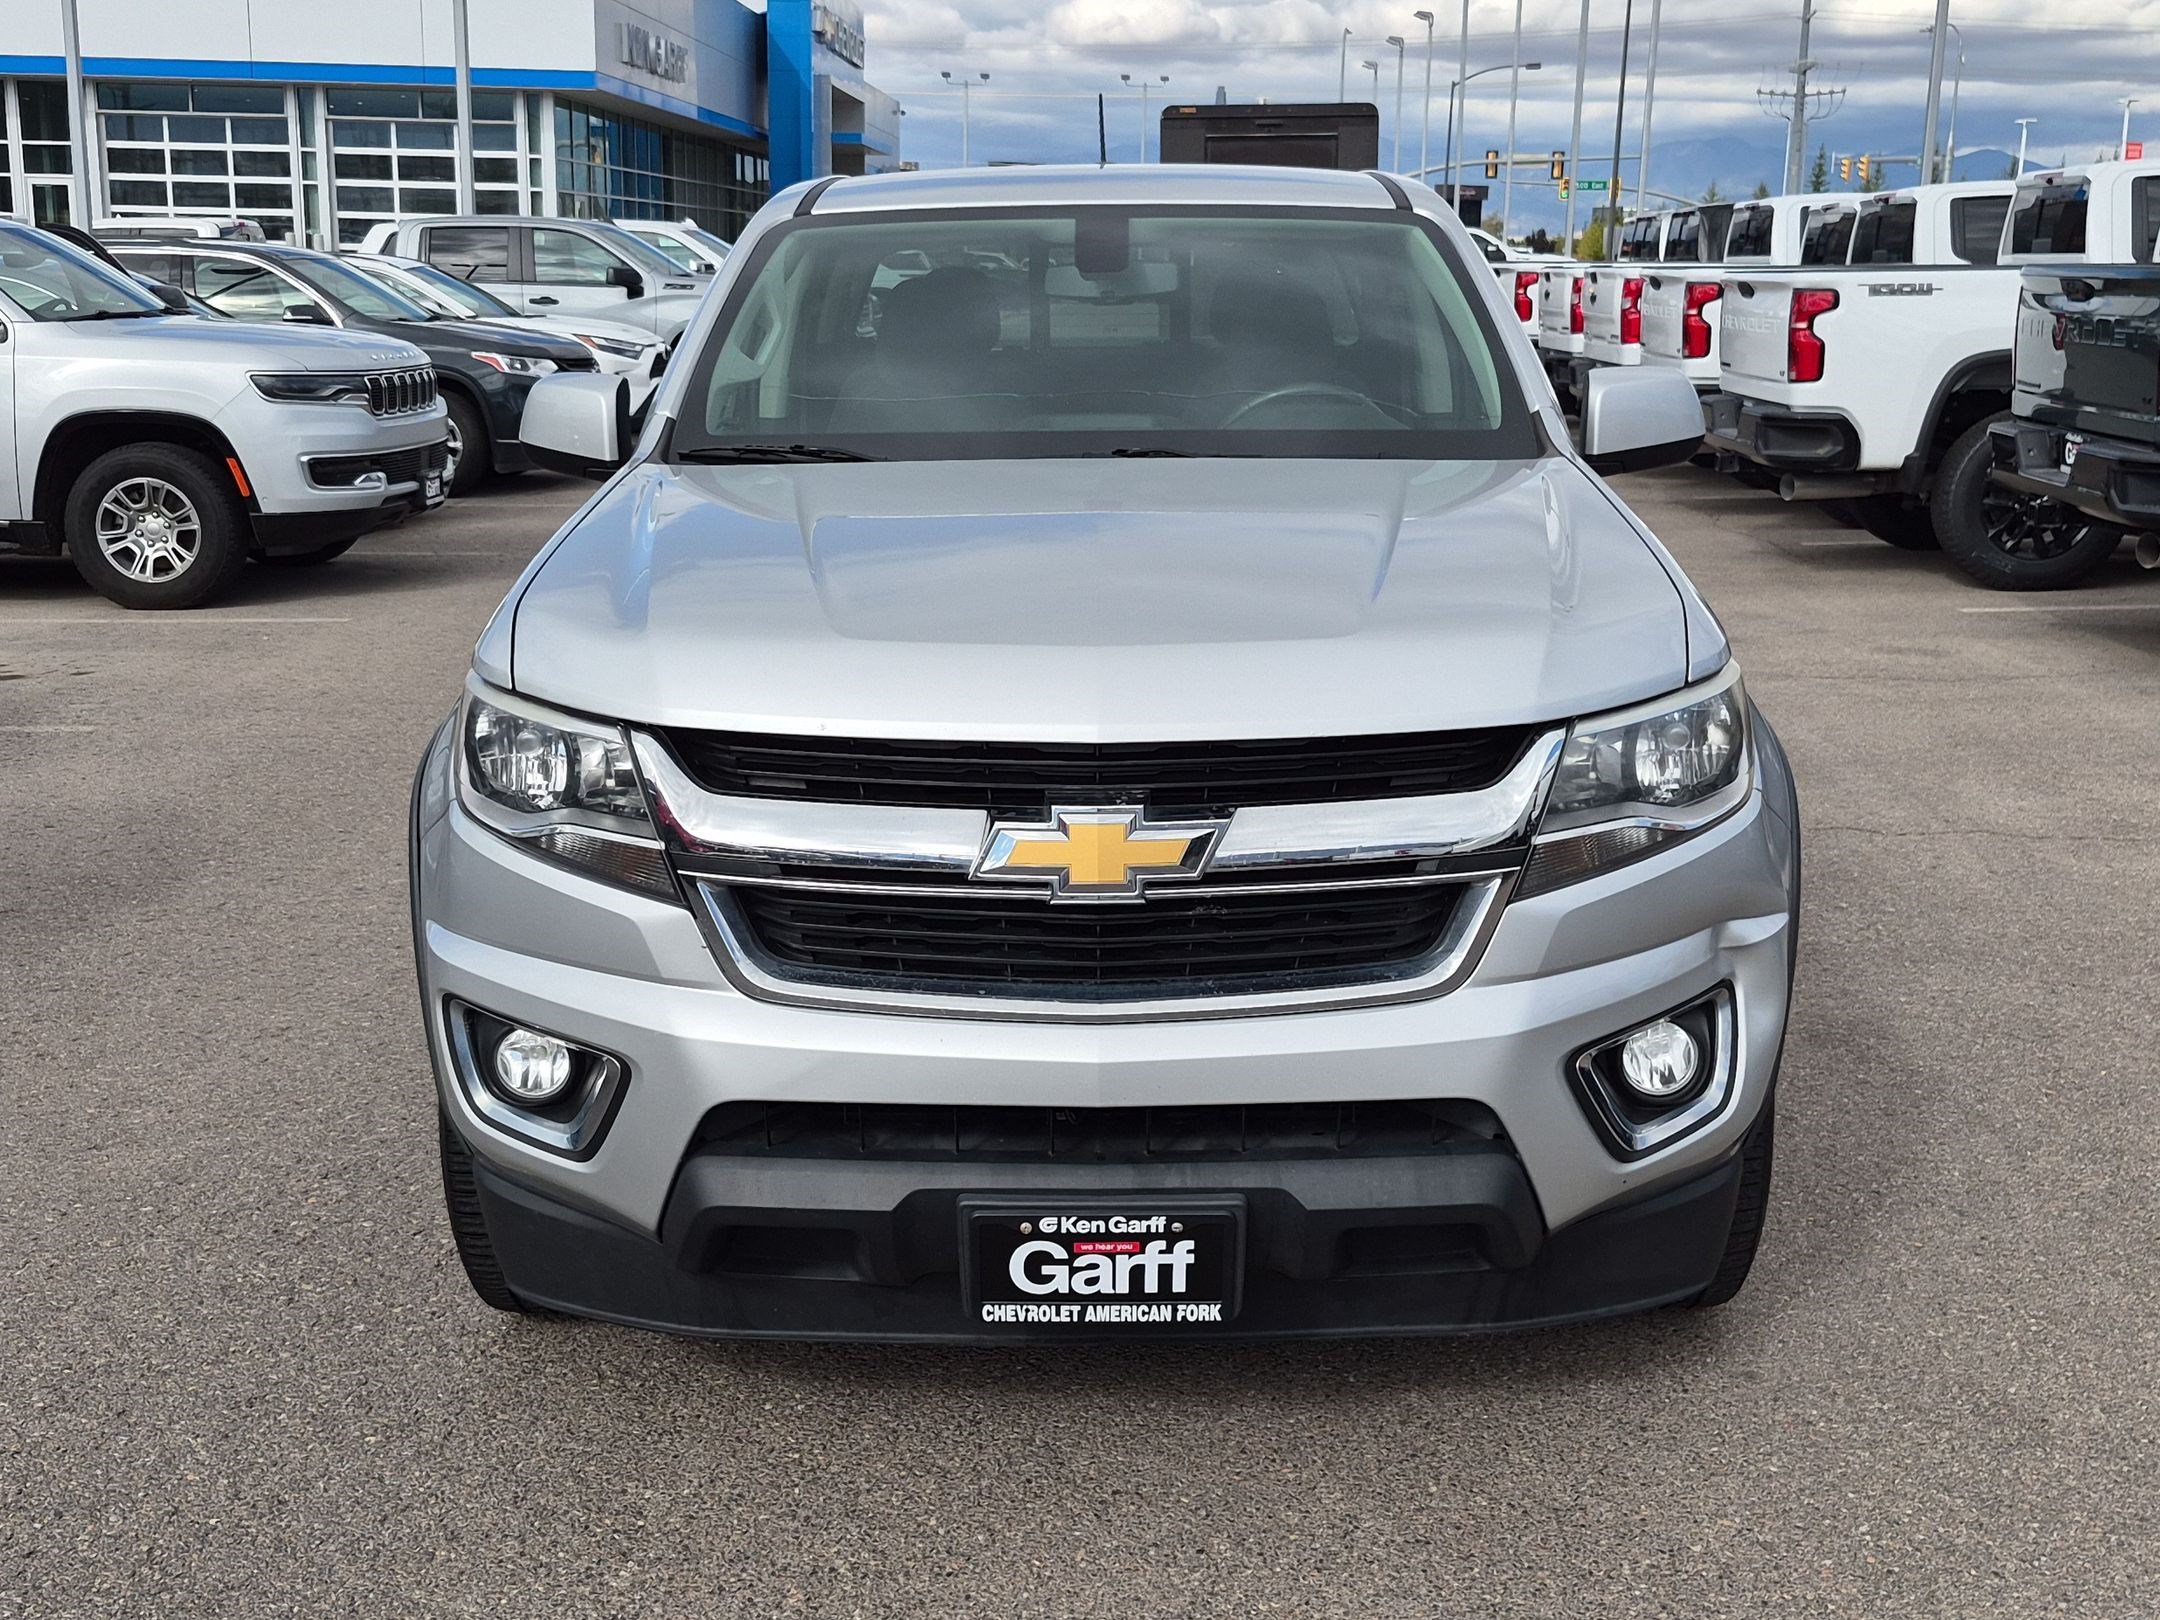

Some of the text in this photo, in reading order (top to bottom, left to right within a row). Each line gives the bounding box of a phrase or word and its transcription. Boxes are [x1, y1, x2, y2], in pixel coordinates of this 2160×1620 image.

[1060, 1216, 1106, 1234] Ken
[1108, 1216, 1167, 1233] Garff
[1095, 1243, 1115, 1251] hear
[1116, 1243, 1133, 1252] you
[1008, 1240, 1195, 1295] Garff
[982, 1304, 1223, 1323] CHEVROLET AMERICAN FORK
